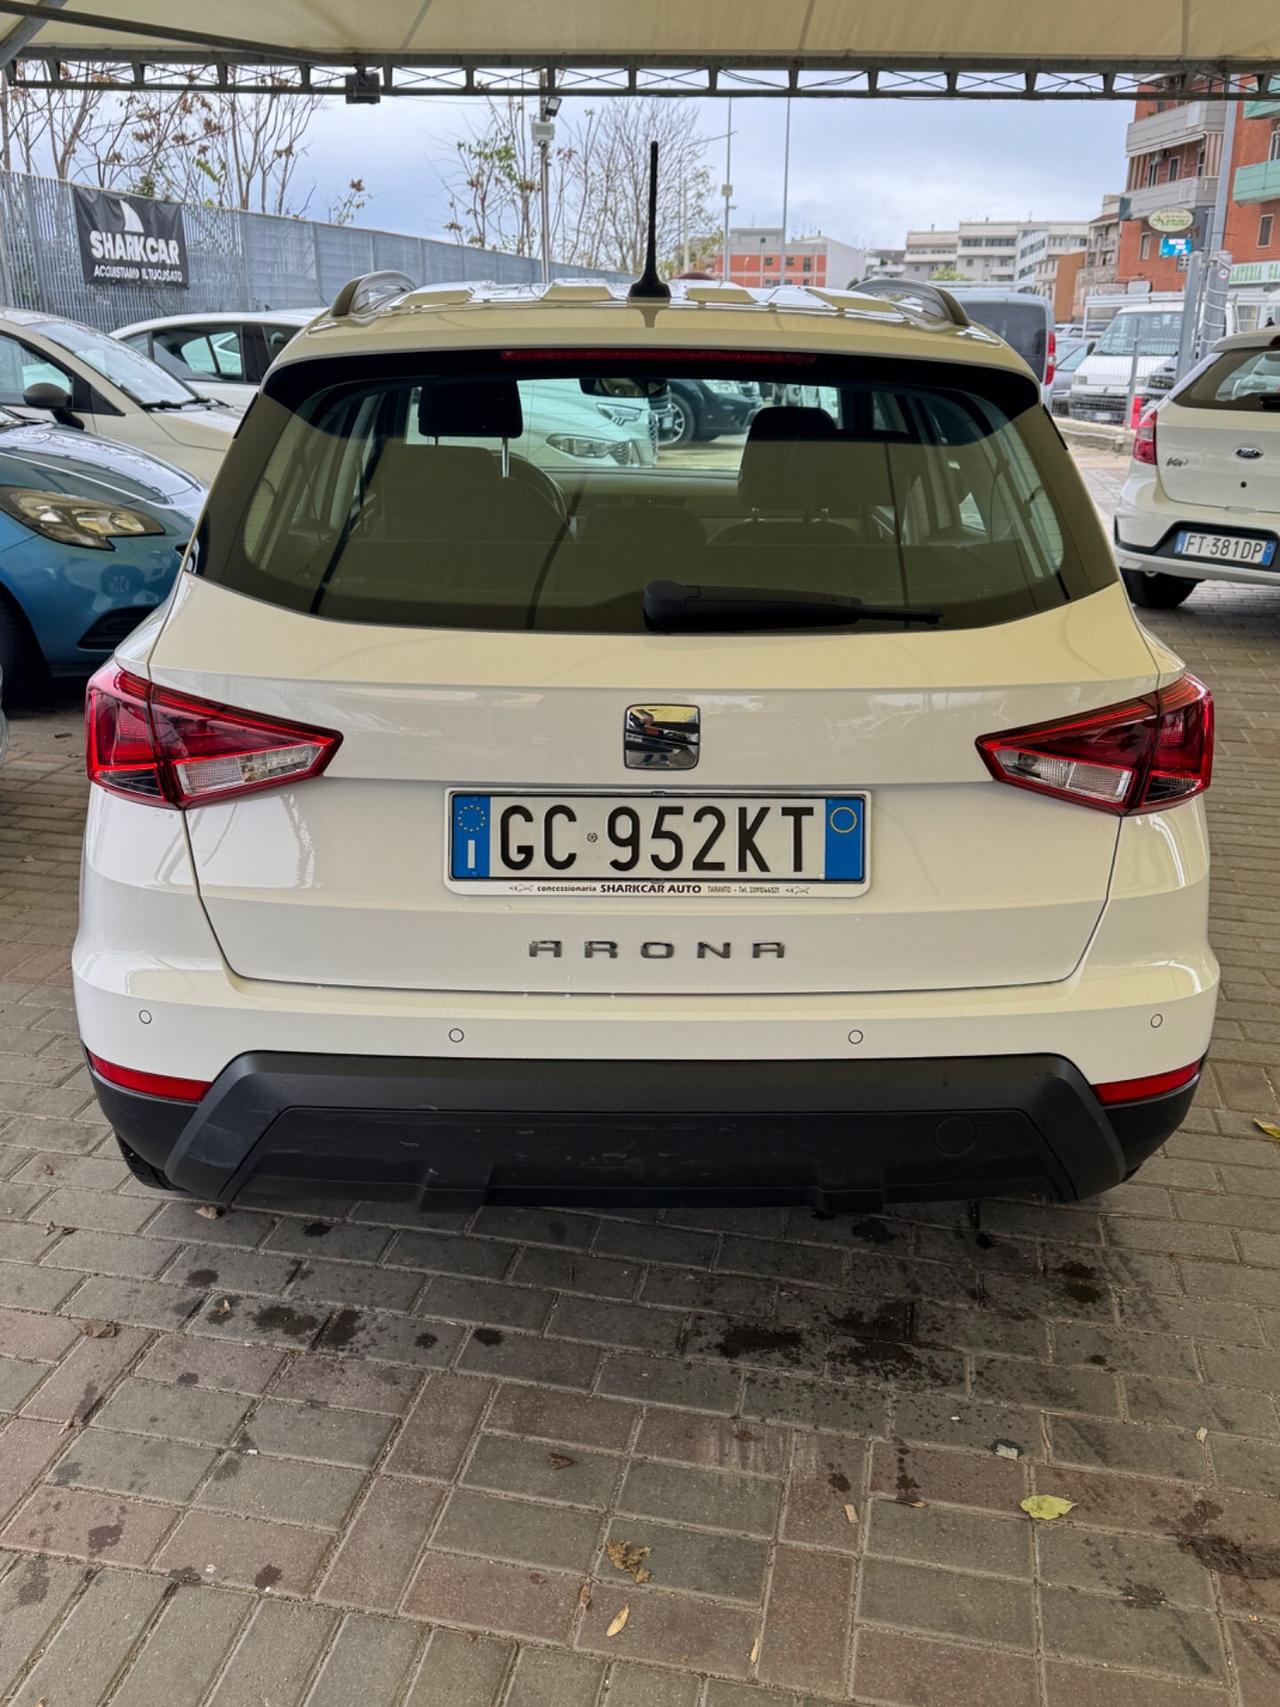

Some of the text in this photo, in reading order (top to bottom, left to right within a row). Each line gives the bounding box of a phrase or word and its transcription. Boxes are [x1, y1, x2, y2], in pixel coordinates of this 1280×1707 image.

[90, 230, 180, 265] SHARKCAR
[1185, 534, 1263, 560] FT 381DP
[500, 804, 577, 871] GC
[607, 804, 815, 873] 952KT
[537, 885, 597, 893] concessionaria
[600, 884, 665, 894] SHARKCAR
[668, 884, 702, 894] AUTO
[528, 940, 786, 959] ARONA
